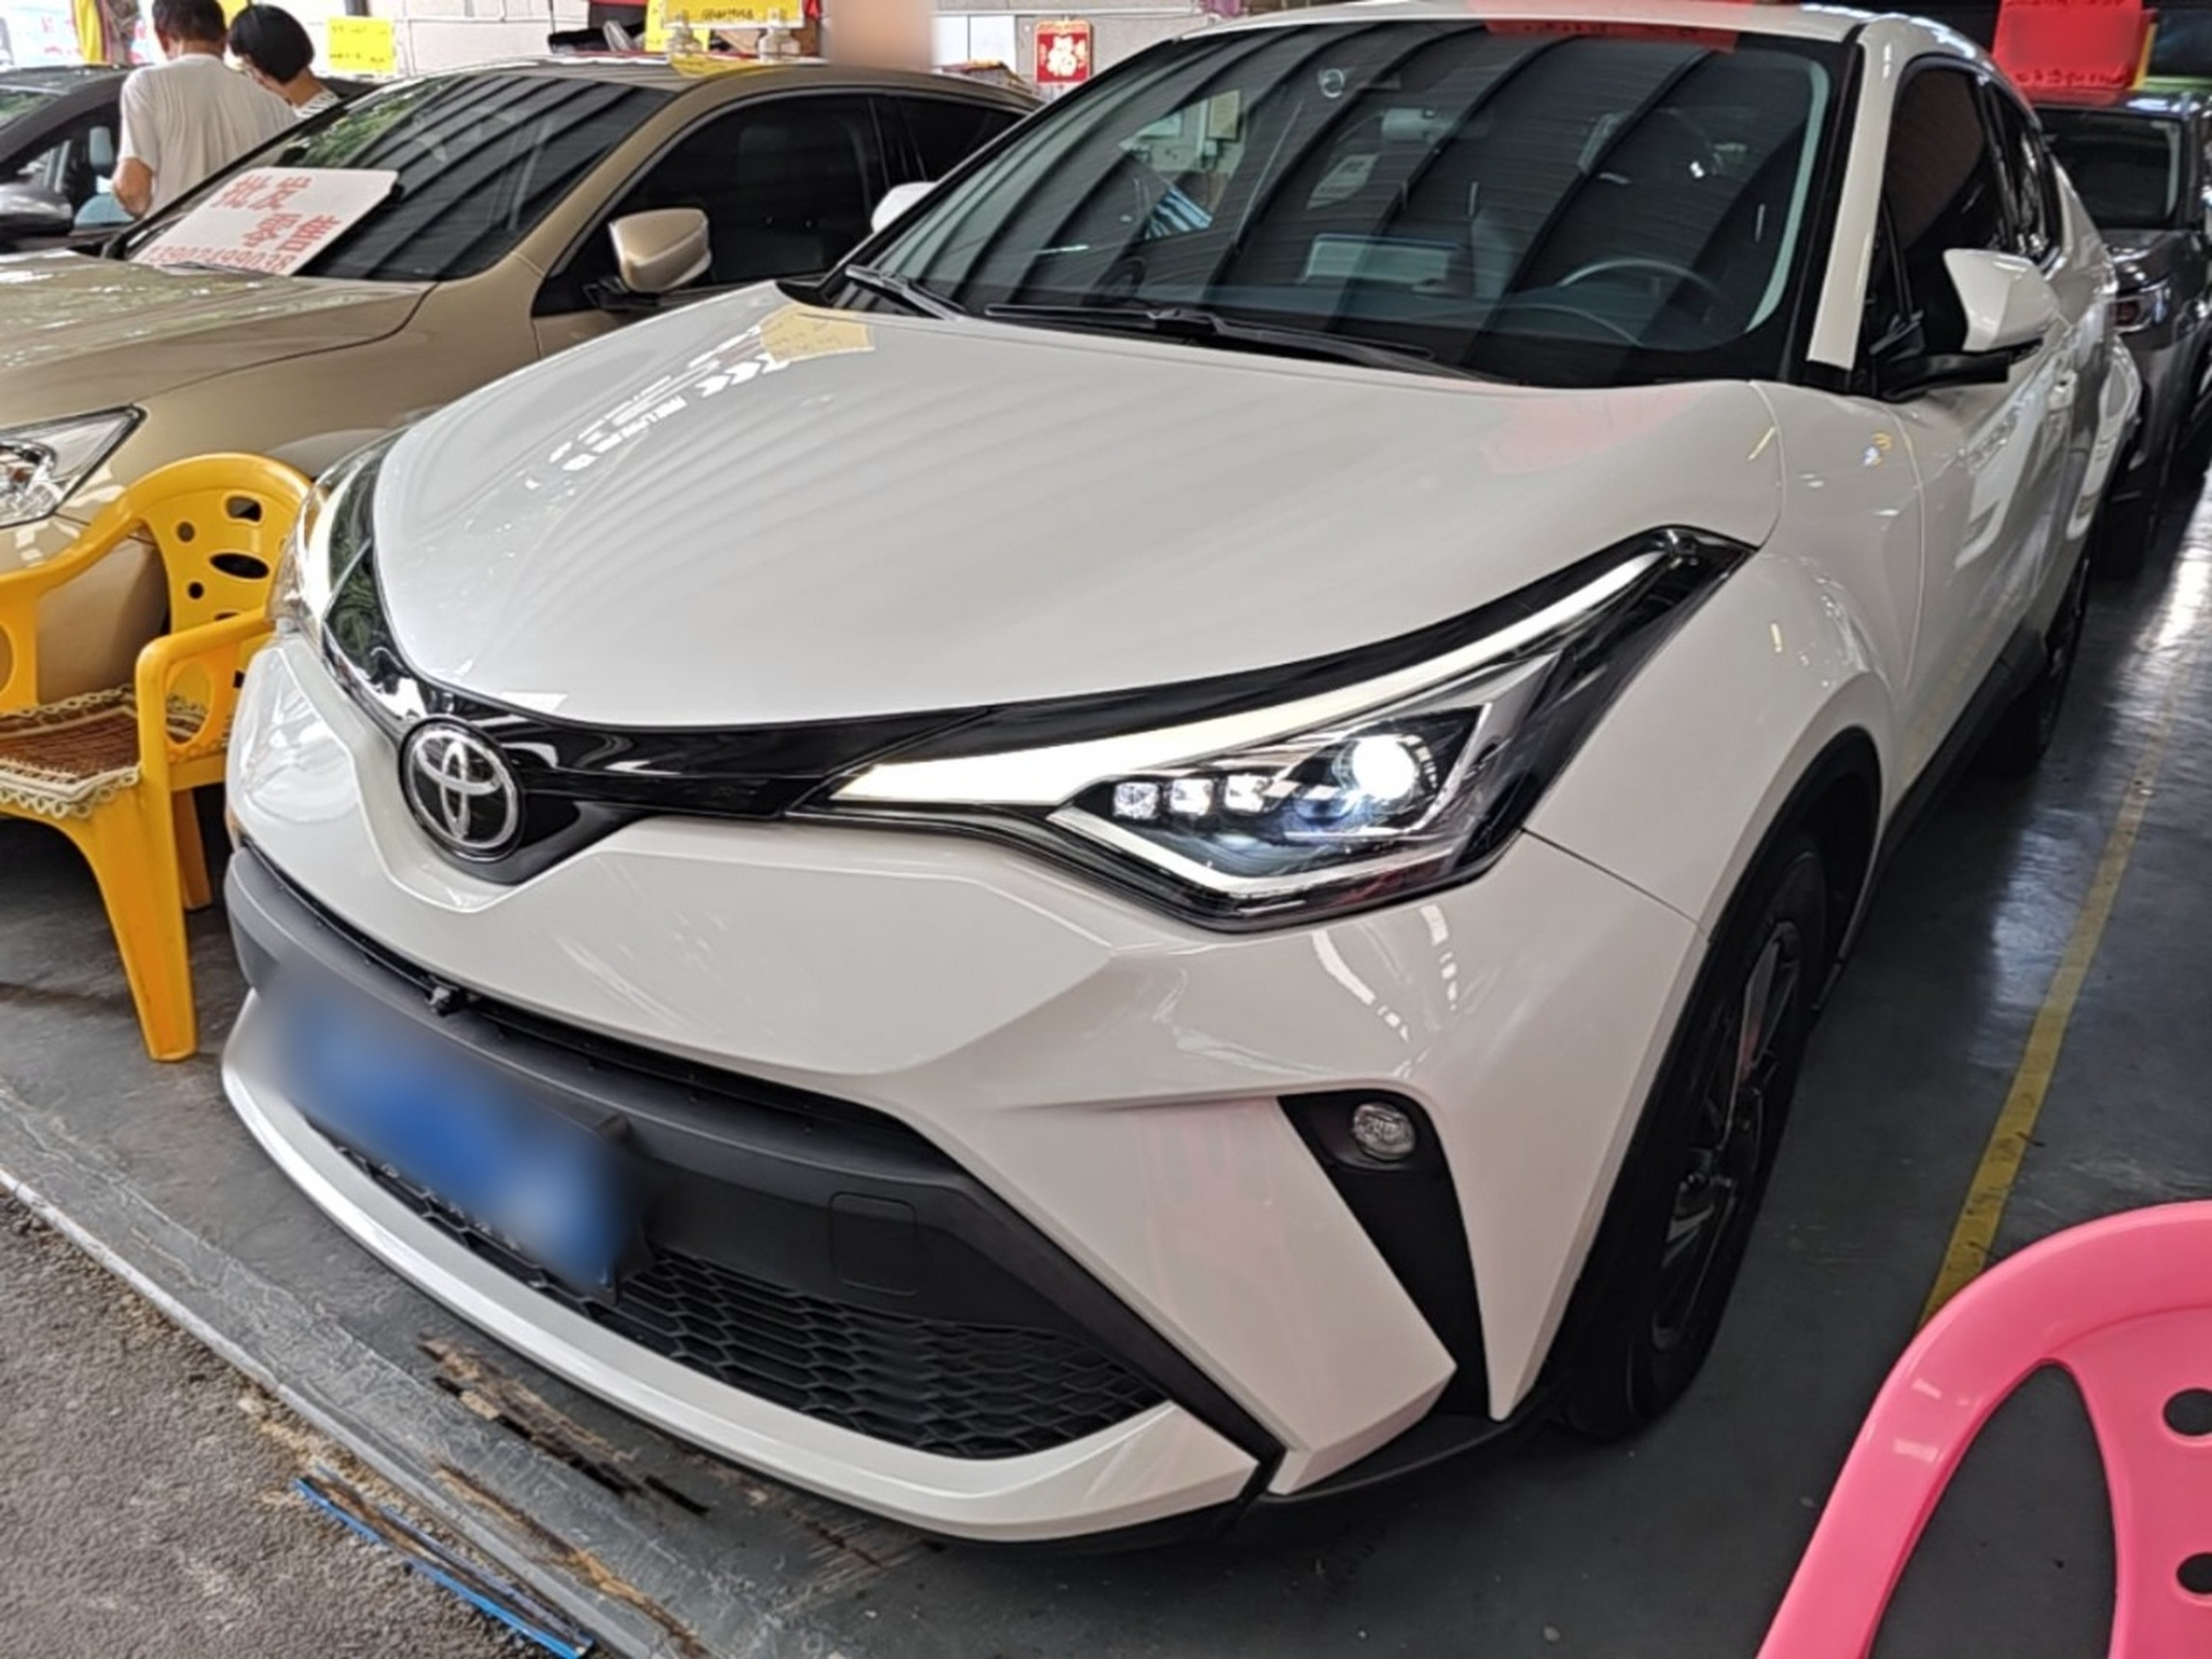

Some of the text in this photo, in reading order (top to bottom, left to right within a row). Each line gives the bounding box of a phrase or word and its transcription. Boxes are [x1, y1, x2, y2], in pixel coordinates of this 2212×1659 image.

[1047, 35, 1077, 77] 福
[211, 175, 312, 210] 批发
[242, 213, 343, 252] 零售
